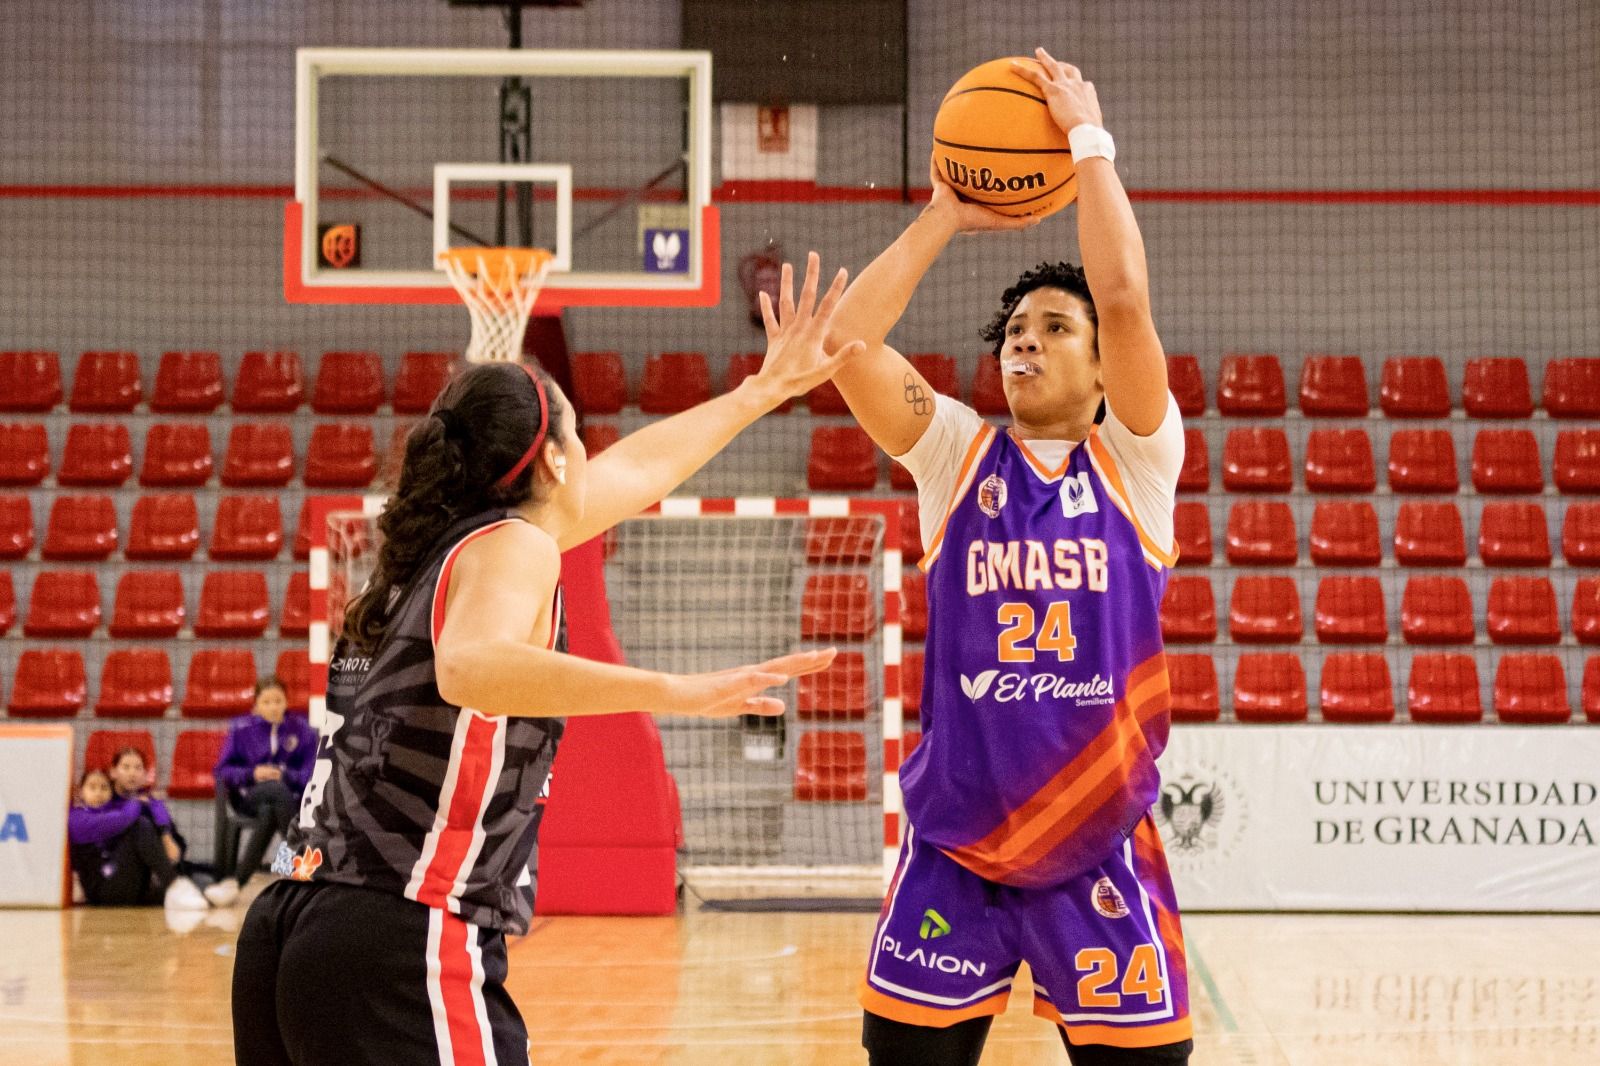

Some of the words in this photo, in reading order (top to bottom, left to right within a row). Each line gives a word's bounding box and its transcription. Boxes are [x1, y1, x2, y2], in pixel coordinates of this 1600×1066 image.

[944, 157, 1047, 192] Wilson
[966, 538, 1109, 597] GMASB
[997, 600, 1078, 663] 24
[994, 673, 1028, 703] El
[1030, 673, 1114, 702] Plantel
[1314, 780, 1598, 806] UNIVERSIDAD
[1314, 820, 1365, 845] DE
[1374, 816, 1596, 845] GRANADA
[881, 935, 986, 977] PLAION
[1074, 943, 1164, 1007] 24
